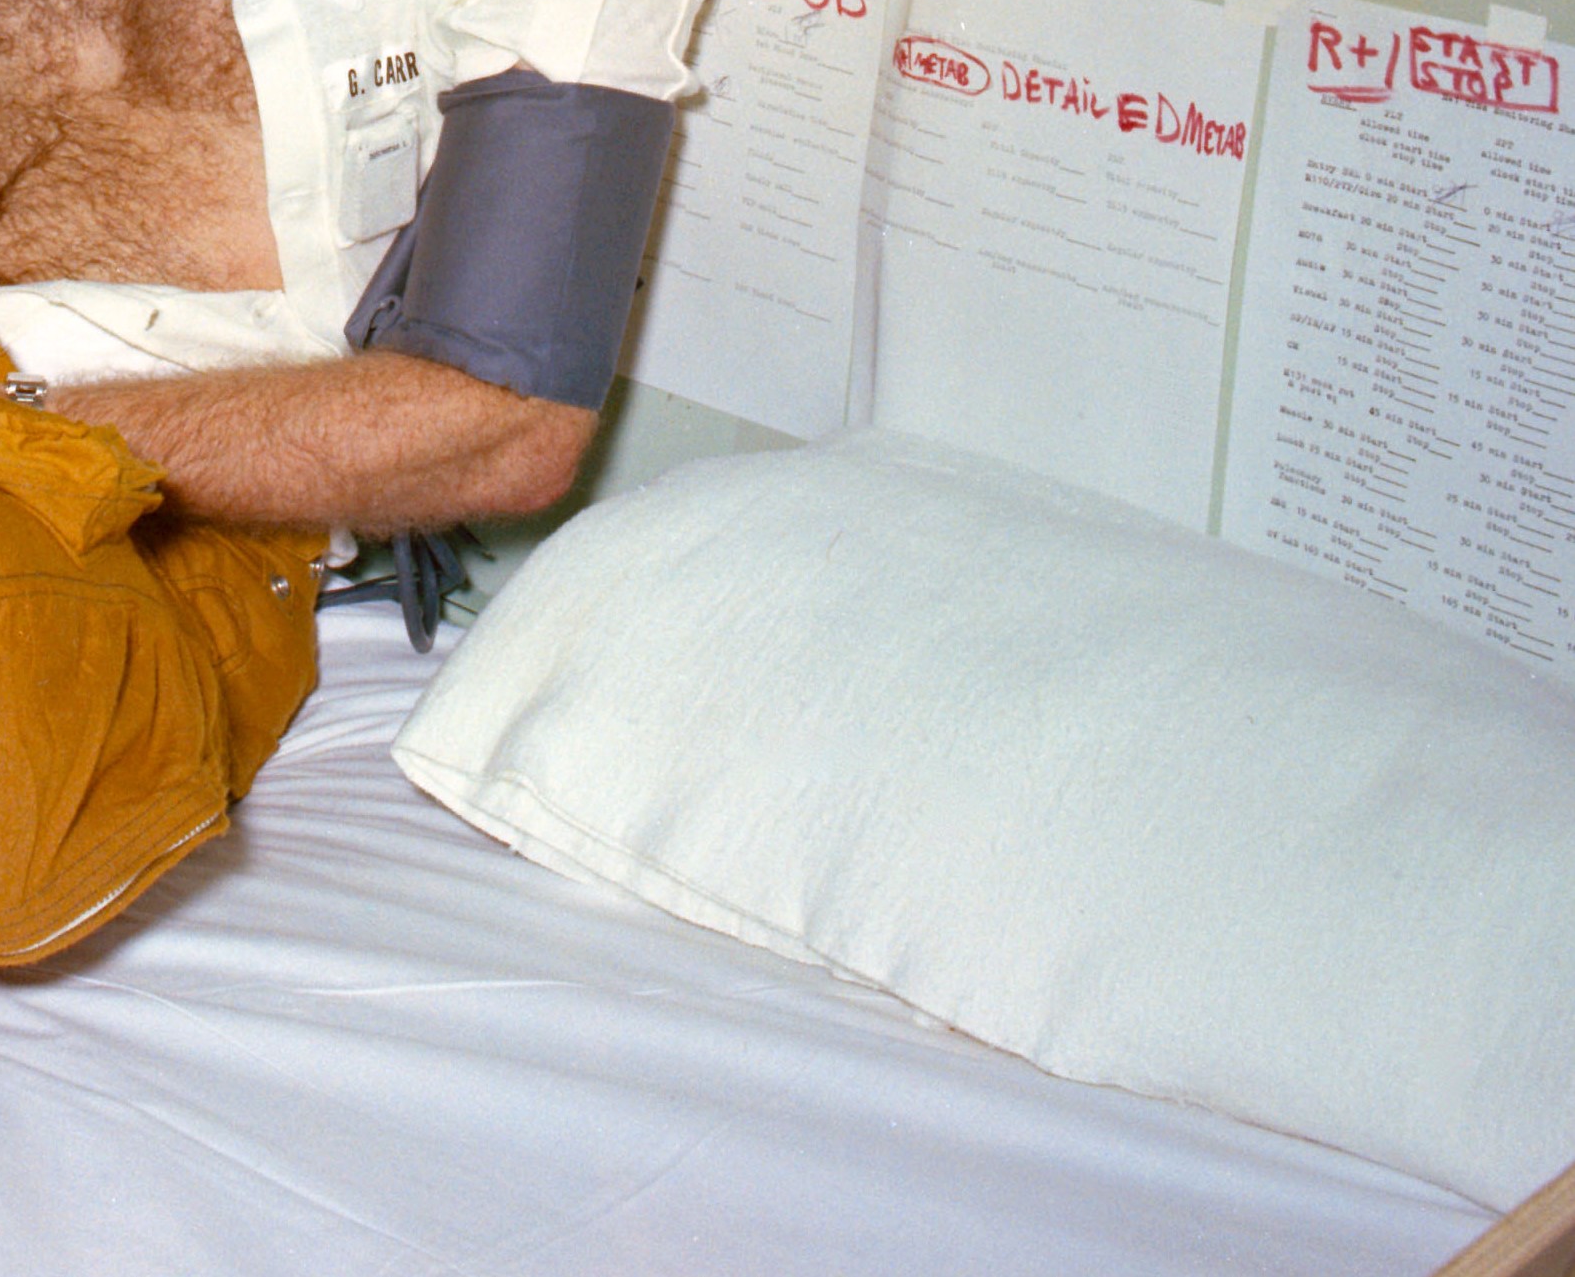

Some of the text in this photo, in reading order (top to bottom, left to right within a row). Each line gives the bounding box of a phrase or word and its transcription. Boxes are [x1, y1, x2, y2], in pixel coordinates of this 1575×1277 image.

[347, 51, 420, 98] G. CARR
[1308, 21, 1401, 90] R+1
[1413, 27, 1539, 86] START
[1419, 61, 1513, 103] STOP
[913, 52, 970, 87] METAB
[1001, 60, 1182, 143] DETAILED
[1180, 101, 1247, 160] METAB
